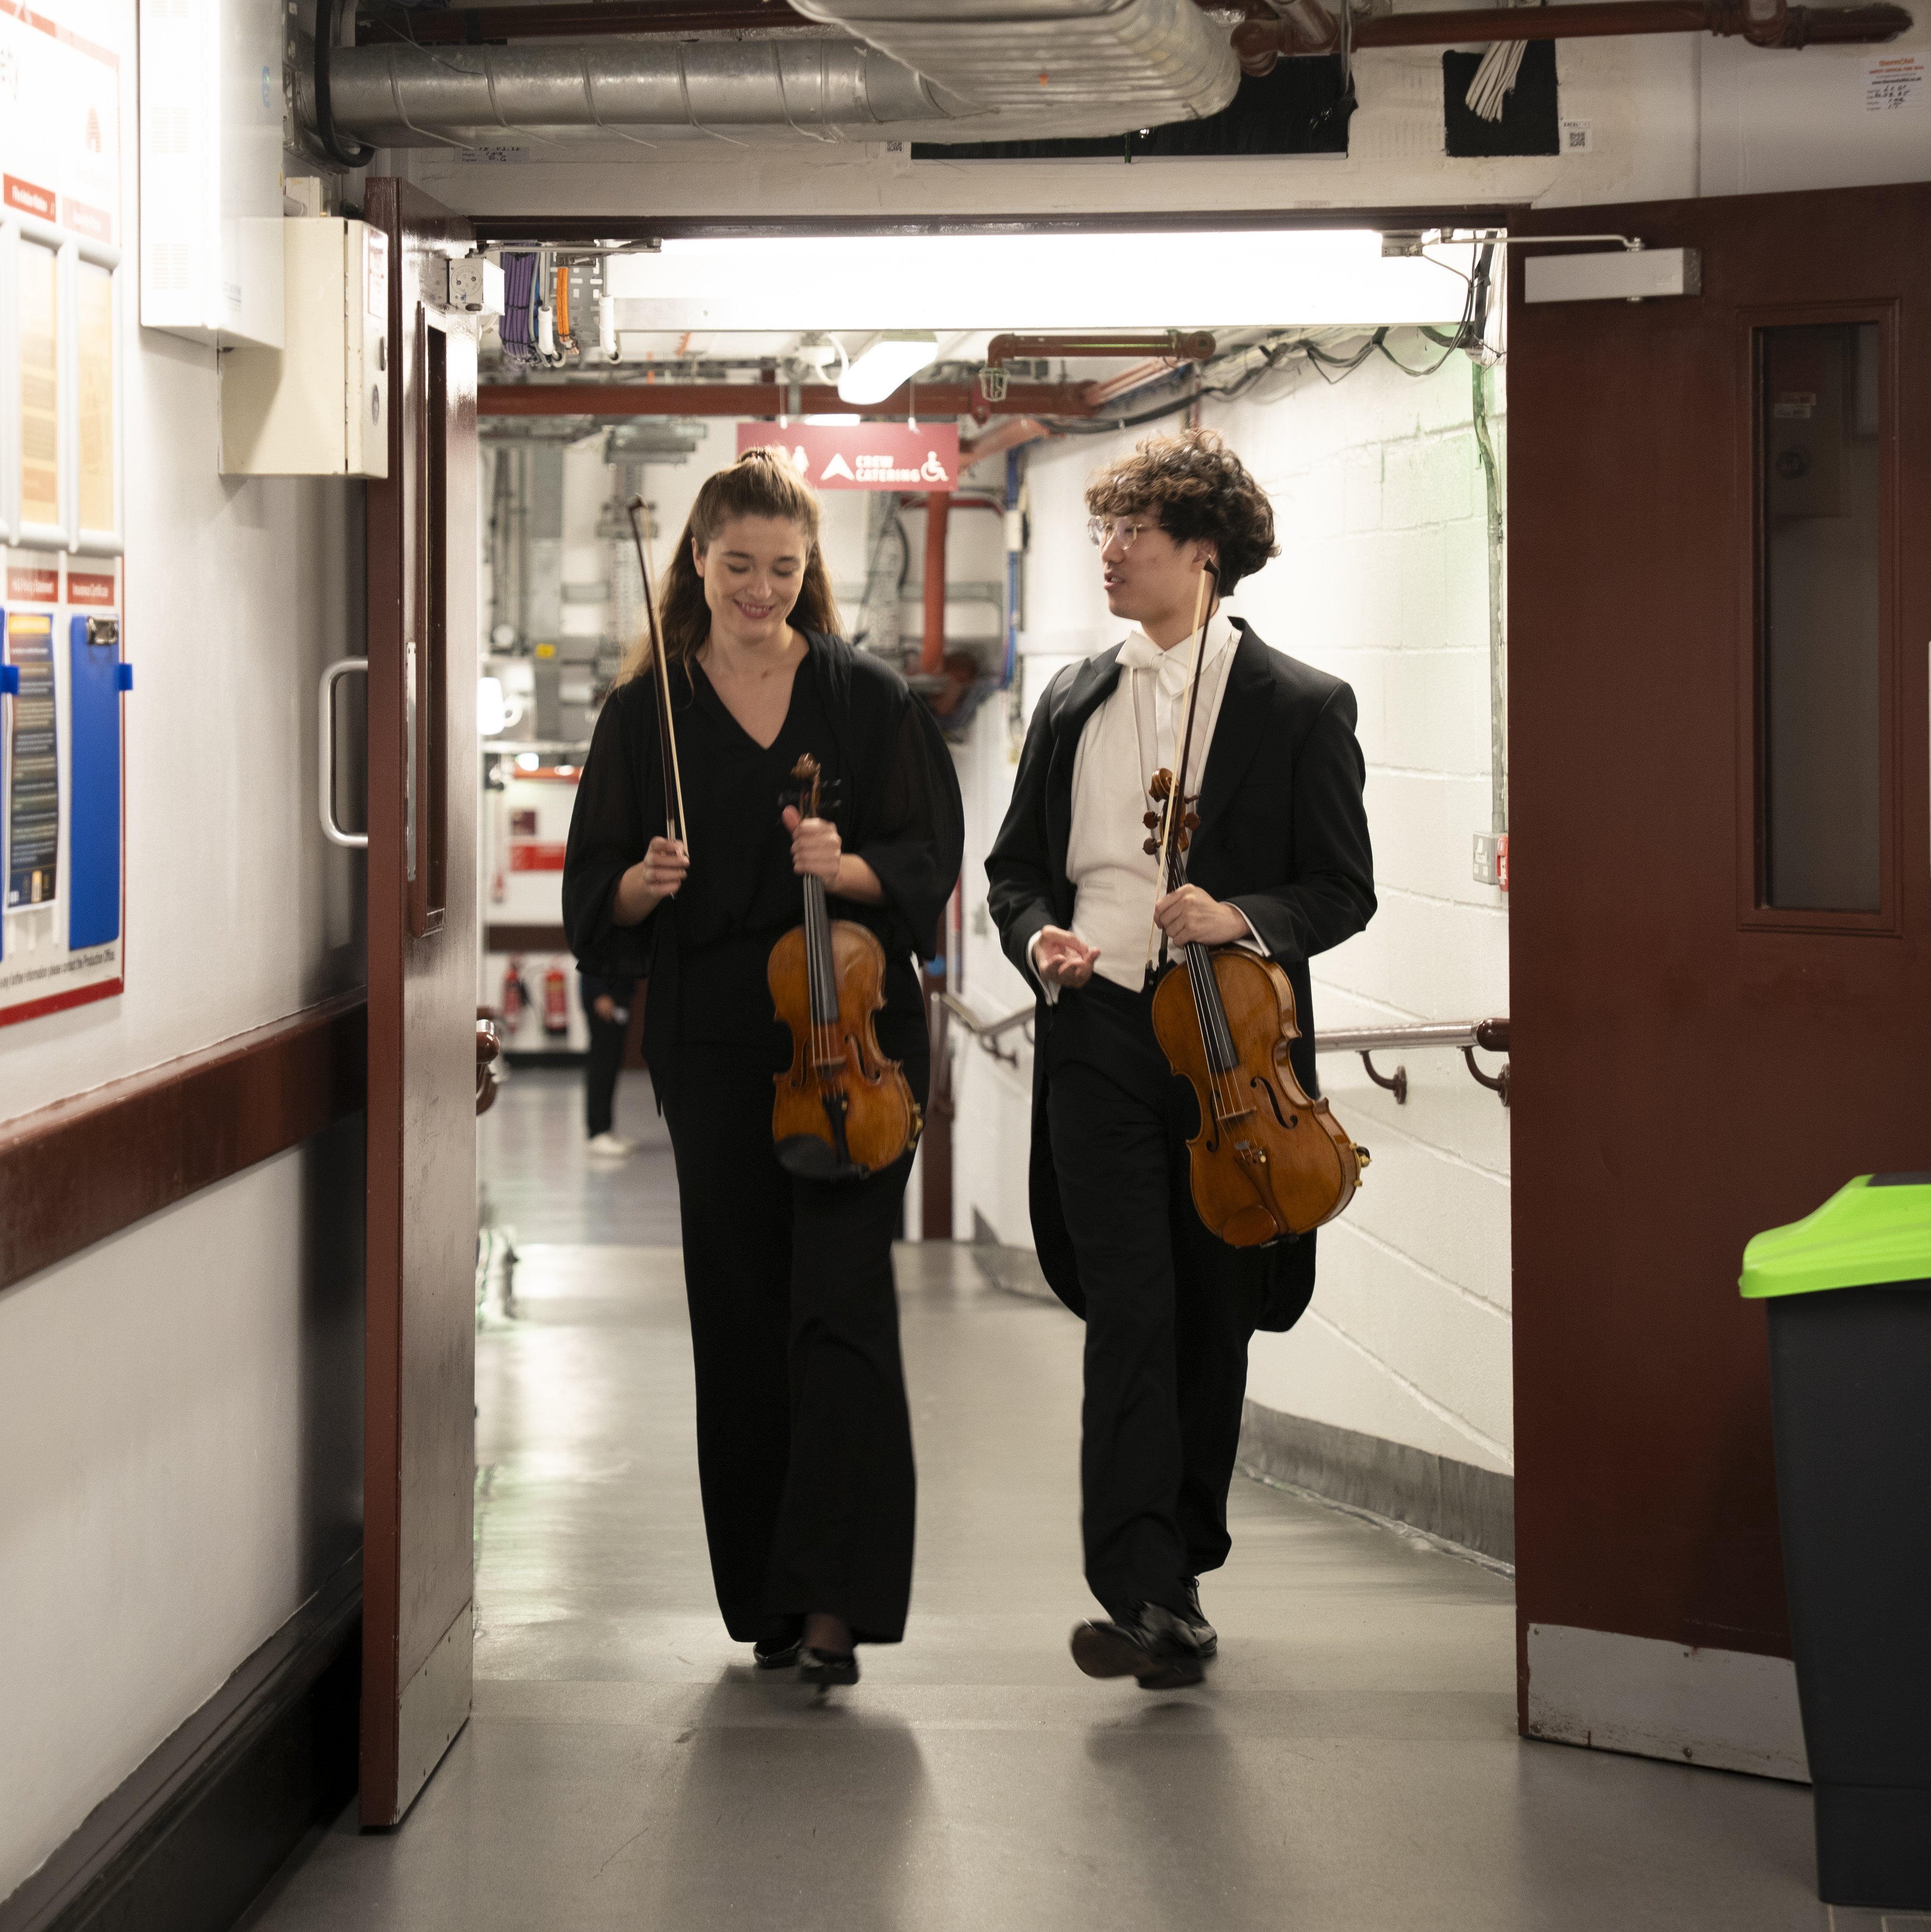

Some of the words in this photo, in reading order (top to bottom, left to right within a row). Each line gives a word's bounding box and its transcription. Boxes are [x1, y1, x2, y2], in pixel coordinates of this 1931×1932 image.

[855, 455, 894, 469] CREW
[855, 468, 921, 482] CATERING
[83, 952, 102, 967] Production
